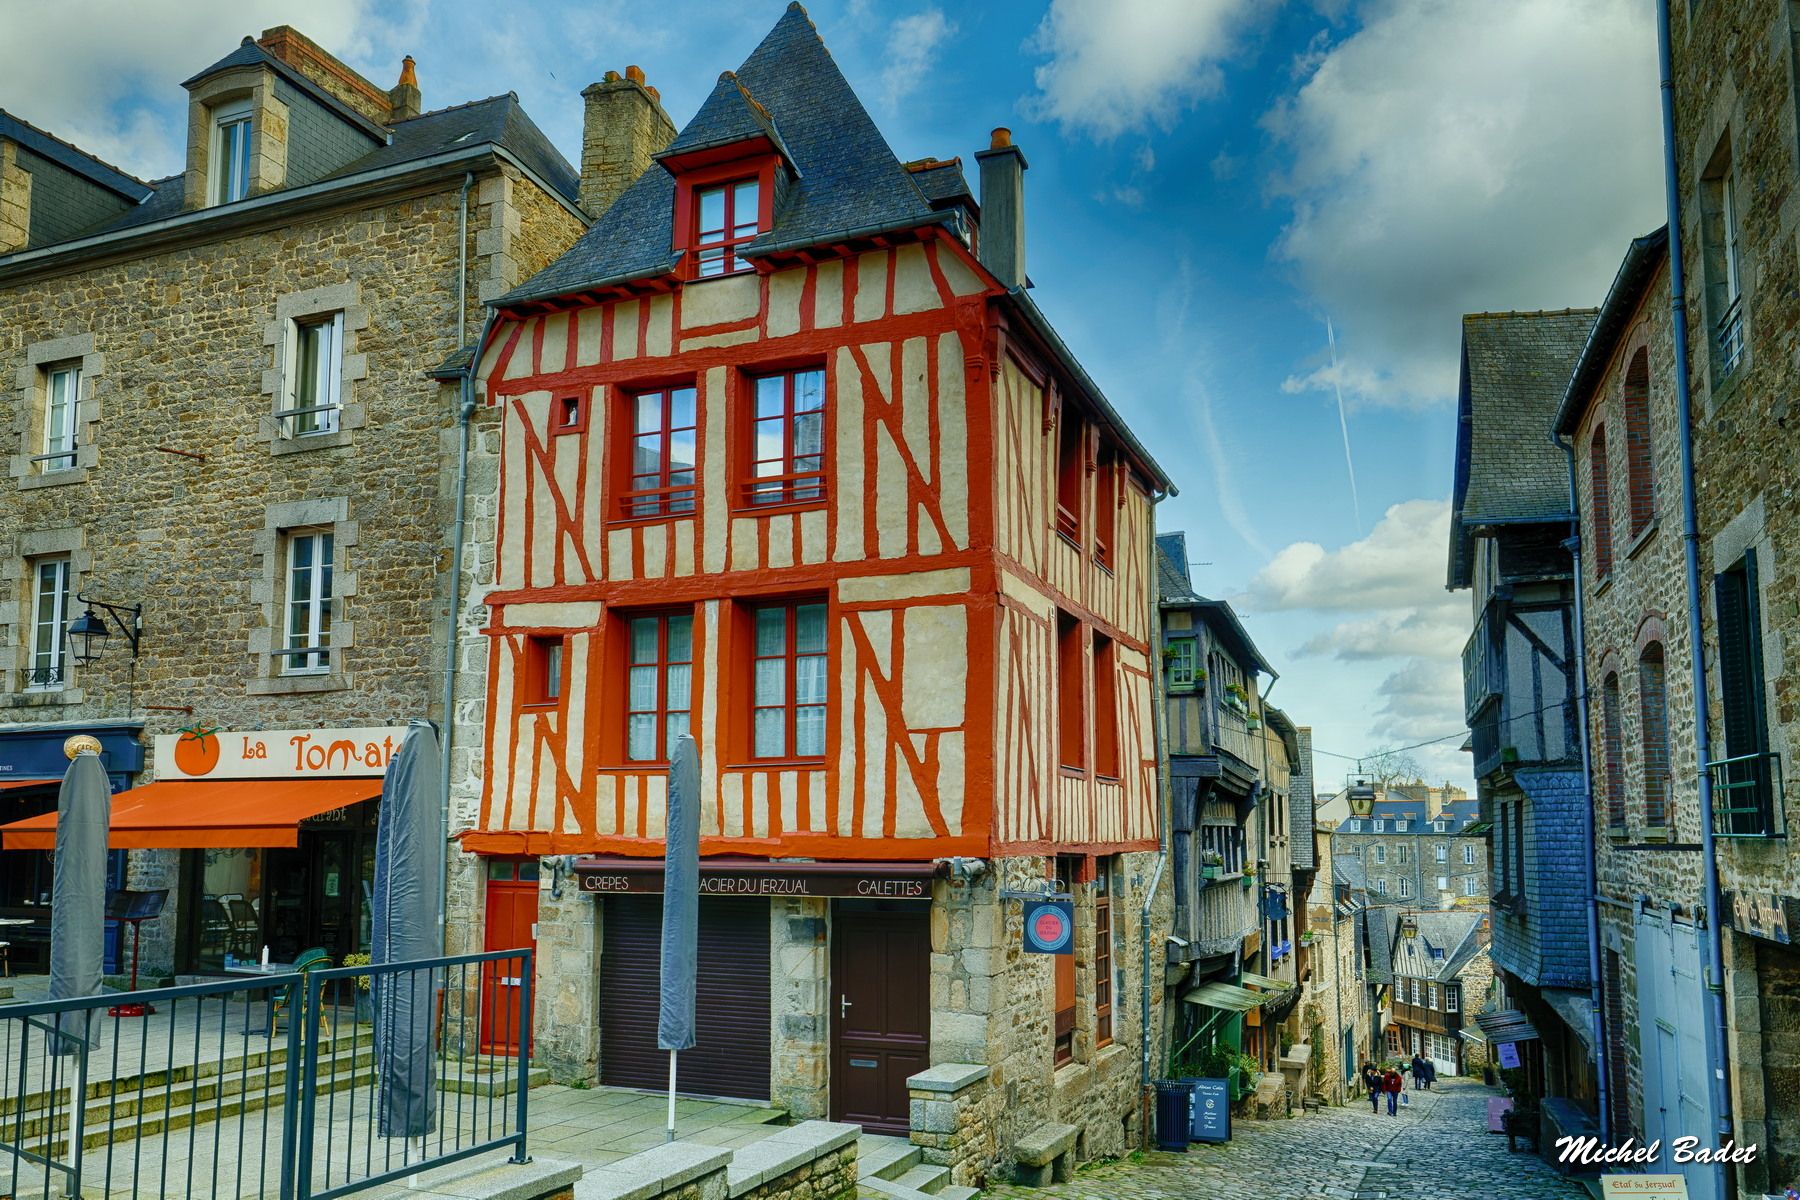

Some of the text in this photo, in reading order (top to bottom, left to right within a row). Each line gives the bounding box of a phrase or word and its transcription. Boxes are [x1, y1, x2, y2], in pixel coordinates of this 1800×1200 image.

[242, 733, 401, 771] La Tomat
[585, 876, 629, 890] CREPES
[699, 878, 810, 894] ACIER DU JERZUAL
[857, 880, 923, 896] GALETTES
[1612, 1180, 1631, 1189] Etal
[1645, 1180, 1677, 1190] Jerzual
